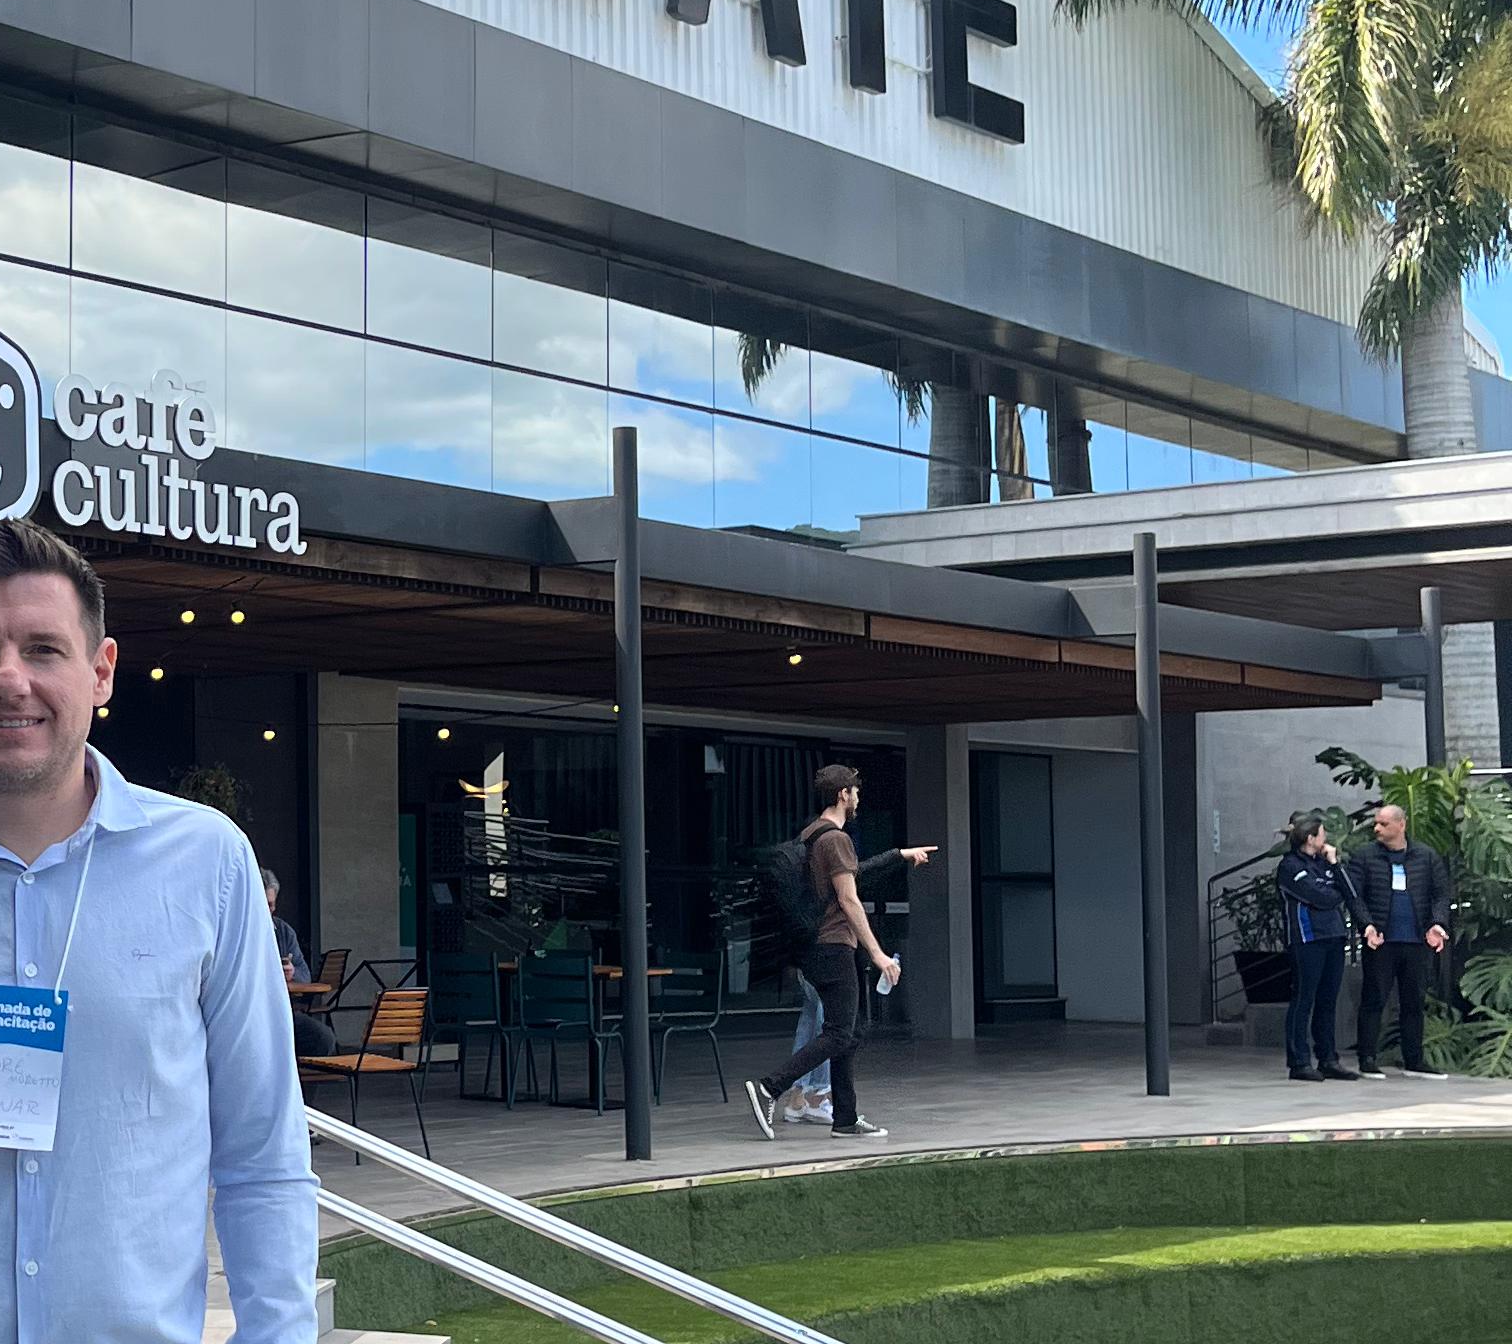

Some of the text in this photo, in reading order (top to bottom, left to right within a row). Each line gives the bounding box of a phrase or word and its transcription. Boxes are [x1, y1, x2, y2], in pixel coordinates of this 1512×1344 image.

[53, 368, 217, 460] café
[52, 454, 308, 556] cultura
[33, 1004, 52, 1018] de
